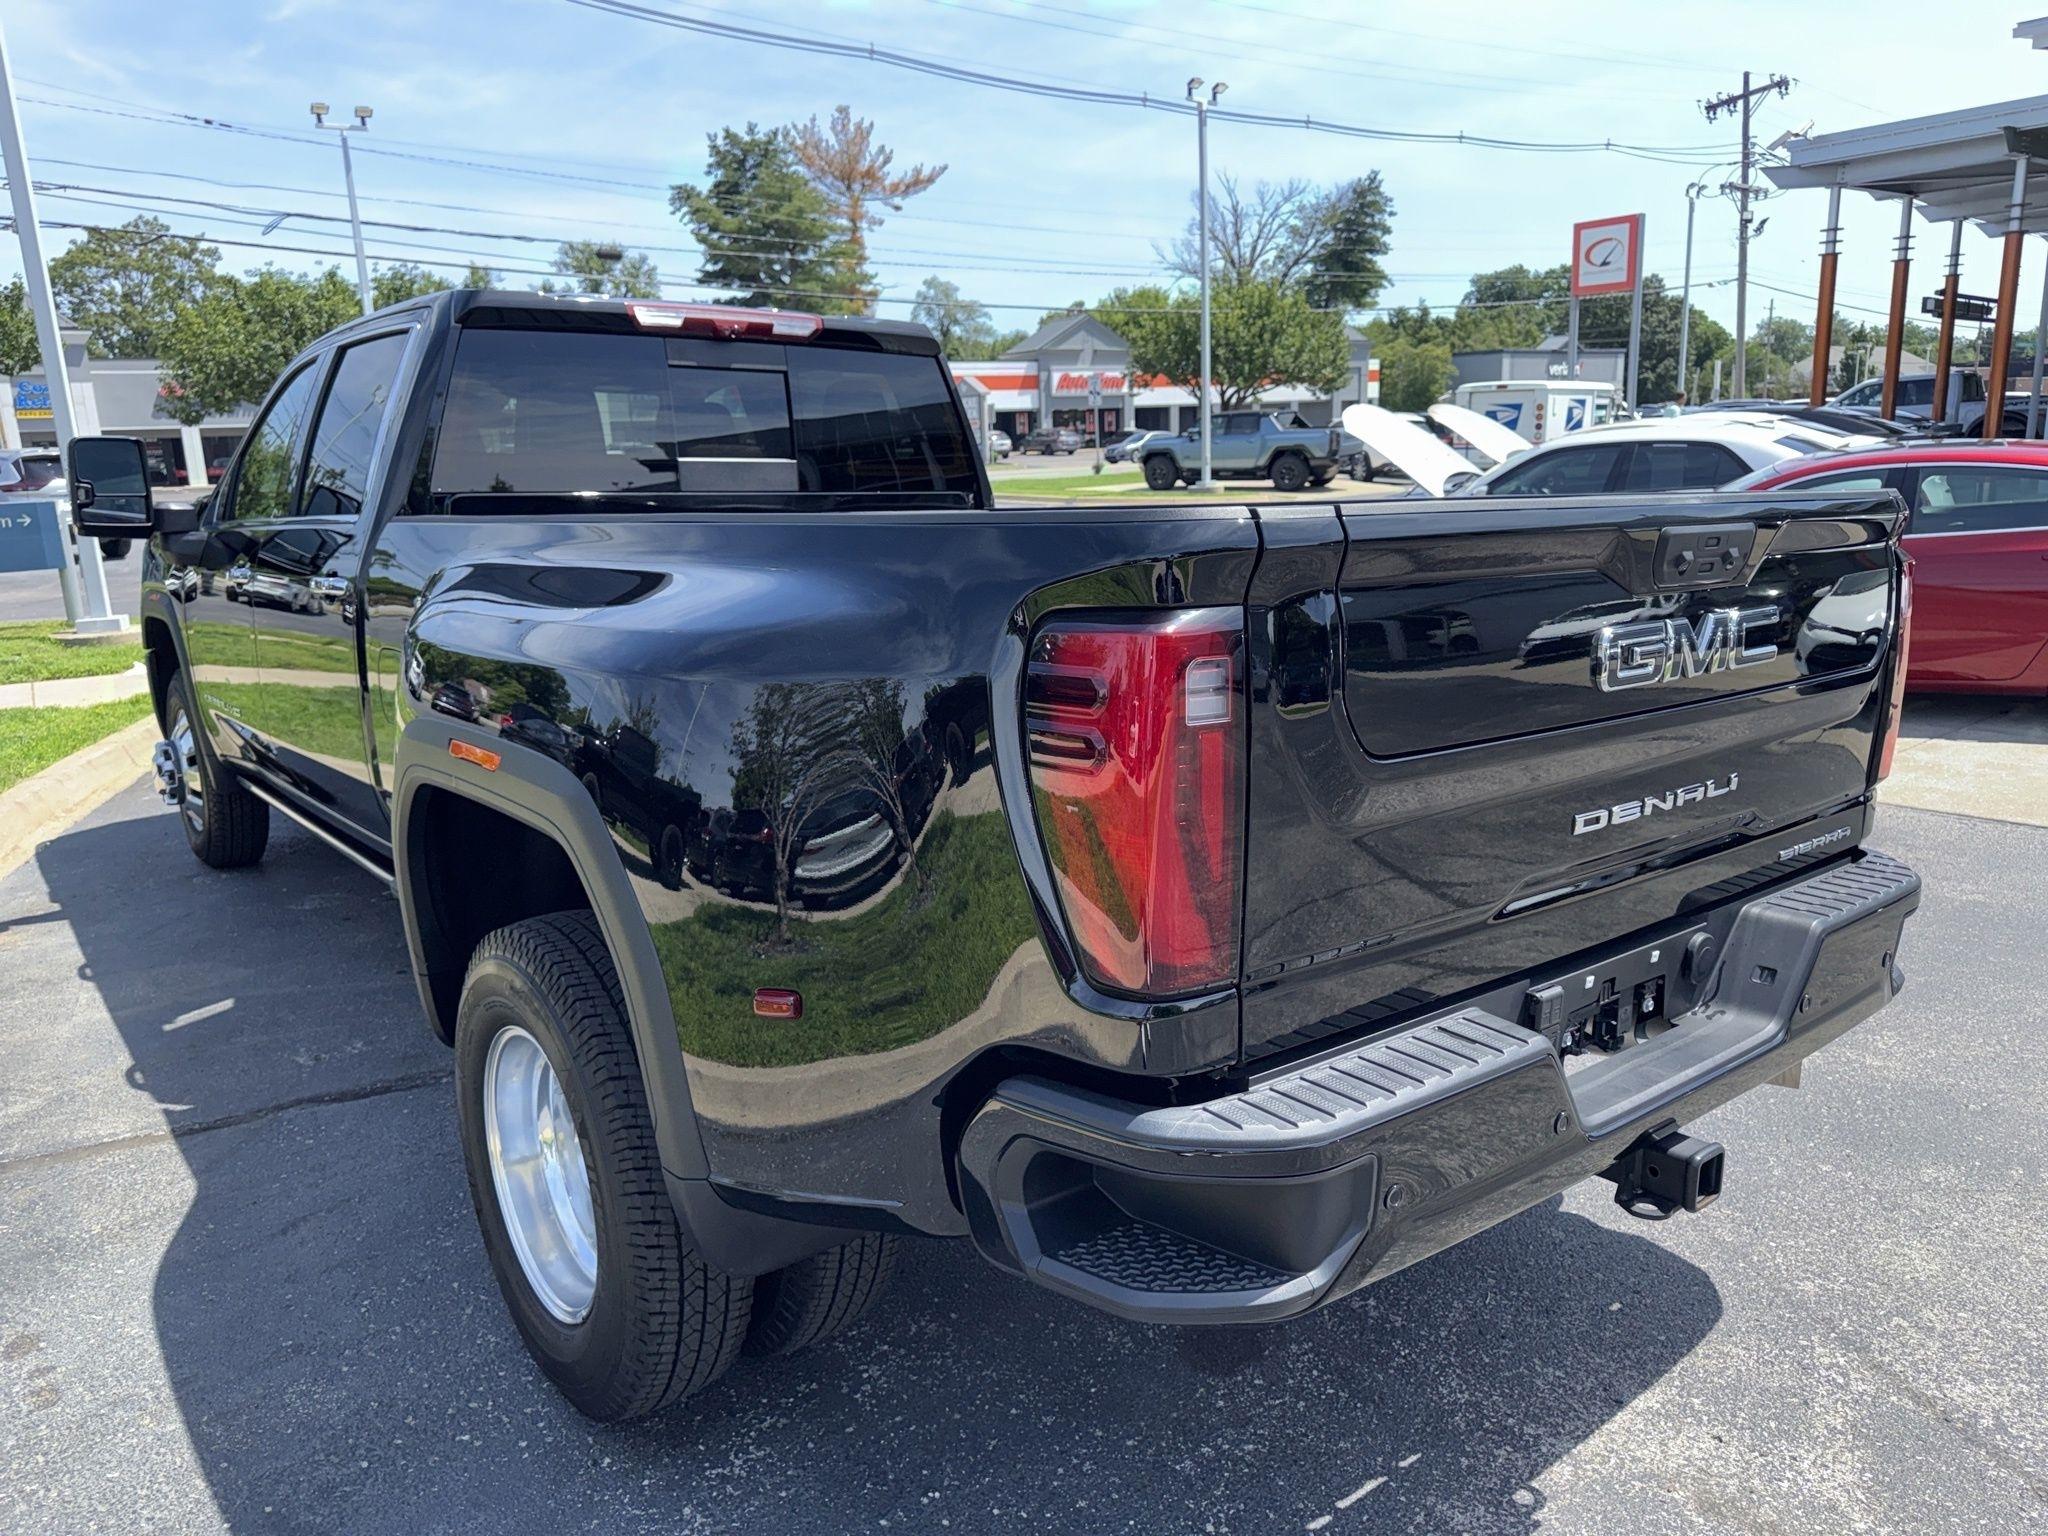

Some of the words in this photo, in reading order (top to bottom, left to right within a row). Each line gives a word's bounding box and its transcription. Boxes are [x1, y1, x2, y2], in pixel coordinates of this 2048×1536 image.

[1591, 605, 1779, 693] GMC
[1572, 772, 1739, 836] DENALI
[1778, 826, 1852, 861] SIERRA
